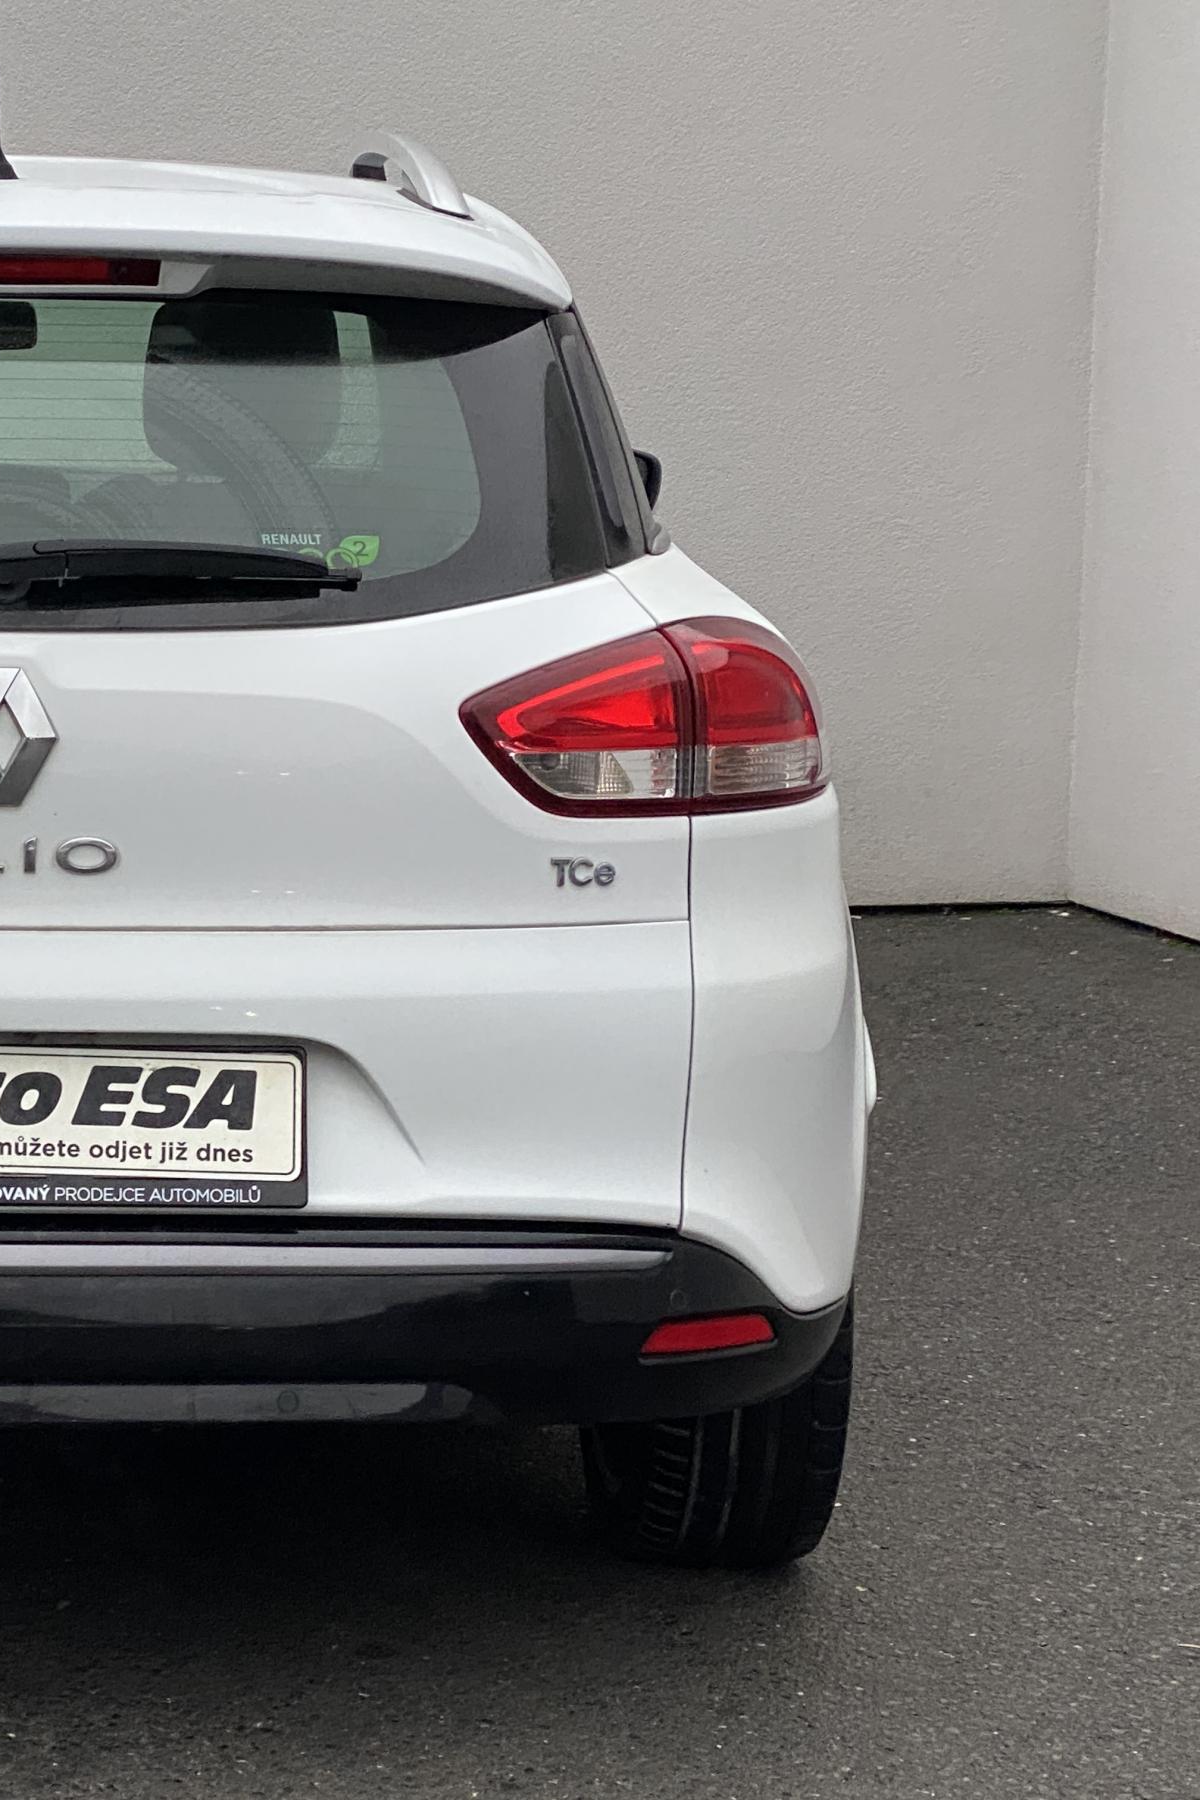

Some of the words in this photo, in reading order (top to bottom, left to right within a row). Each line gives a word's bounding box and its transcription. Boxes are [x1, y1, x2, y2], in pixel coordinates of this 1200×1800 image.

[260, 533, 323, 546] RENAULT
[550, 856, 616, 888] TCe
[70, 1064, 258, 1131] ESA
[88, 1140, 153, 1162] odjet
[159, 1141, 188, 1164] již
[195, 1143, 254, 1163] dnes
[54, 1186, 146, 1203] PRODEJCE
[148, 1185, 261, 1204] AUTOMOBILŮ
